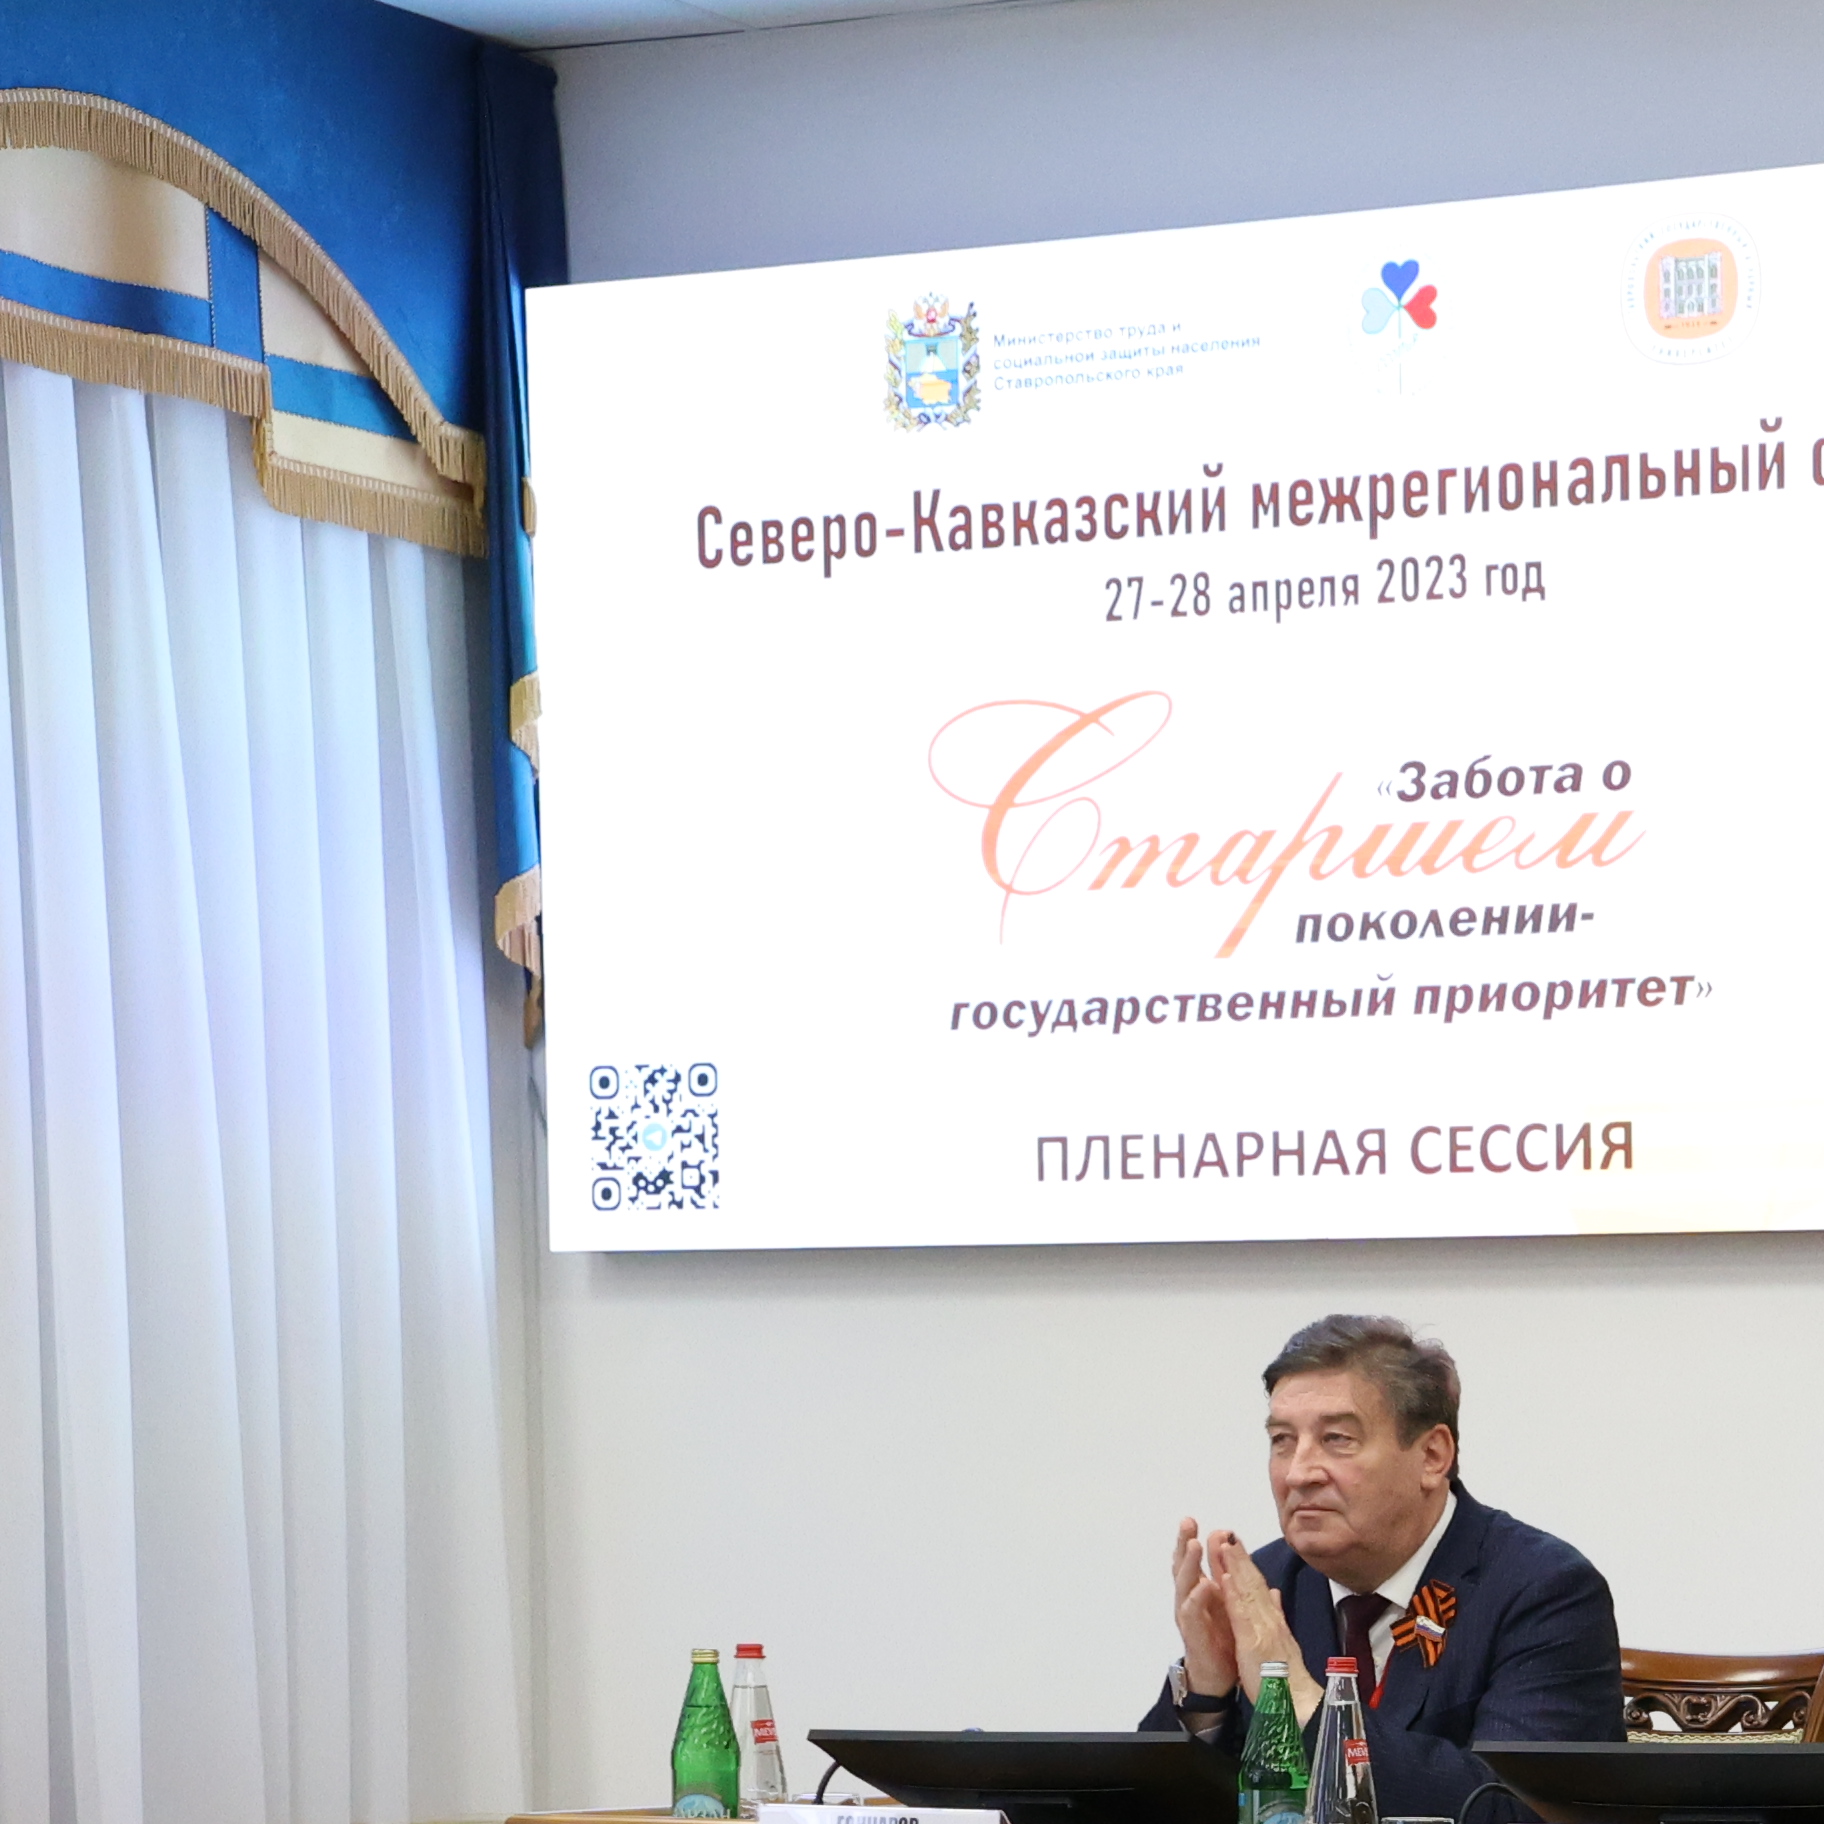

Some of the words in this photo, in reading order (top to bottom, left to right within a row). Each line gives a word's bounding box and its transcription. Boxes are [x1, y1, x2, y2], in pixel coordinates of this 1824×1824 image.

[994, 326, 1113, 348] Министерство
[1171, 336, 1262, 355] населения
[994, 366, 1140, 391] Ставропольского
[696, 462, 1227, 578] Северо-Кавказский
[1251, 416, 1785, 540] межрегиональный
[1105, 571, 1211, 622] 27-28
[1228, 568, 1359, 624] апреля
[1376, 553, 1467, 604] 2023
[1485, 560, 1546, 602] год
[1377, 754, 1584, 803] «Забота
[1601, 759, 1632, 792] о
[929, 690, 1646, 960] Старшем
[1295, 902, 1595, 944] поколении-
[950, 973, 1396, 1038] государственный
[1413, 975, 1713, 1024] приоритет»
[1037, 1127, 1387, 1182] ПЛЕНАРНАЯ
[1410, 1120, 1634, 1175] СЕССИЯ
